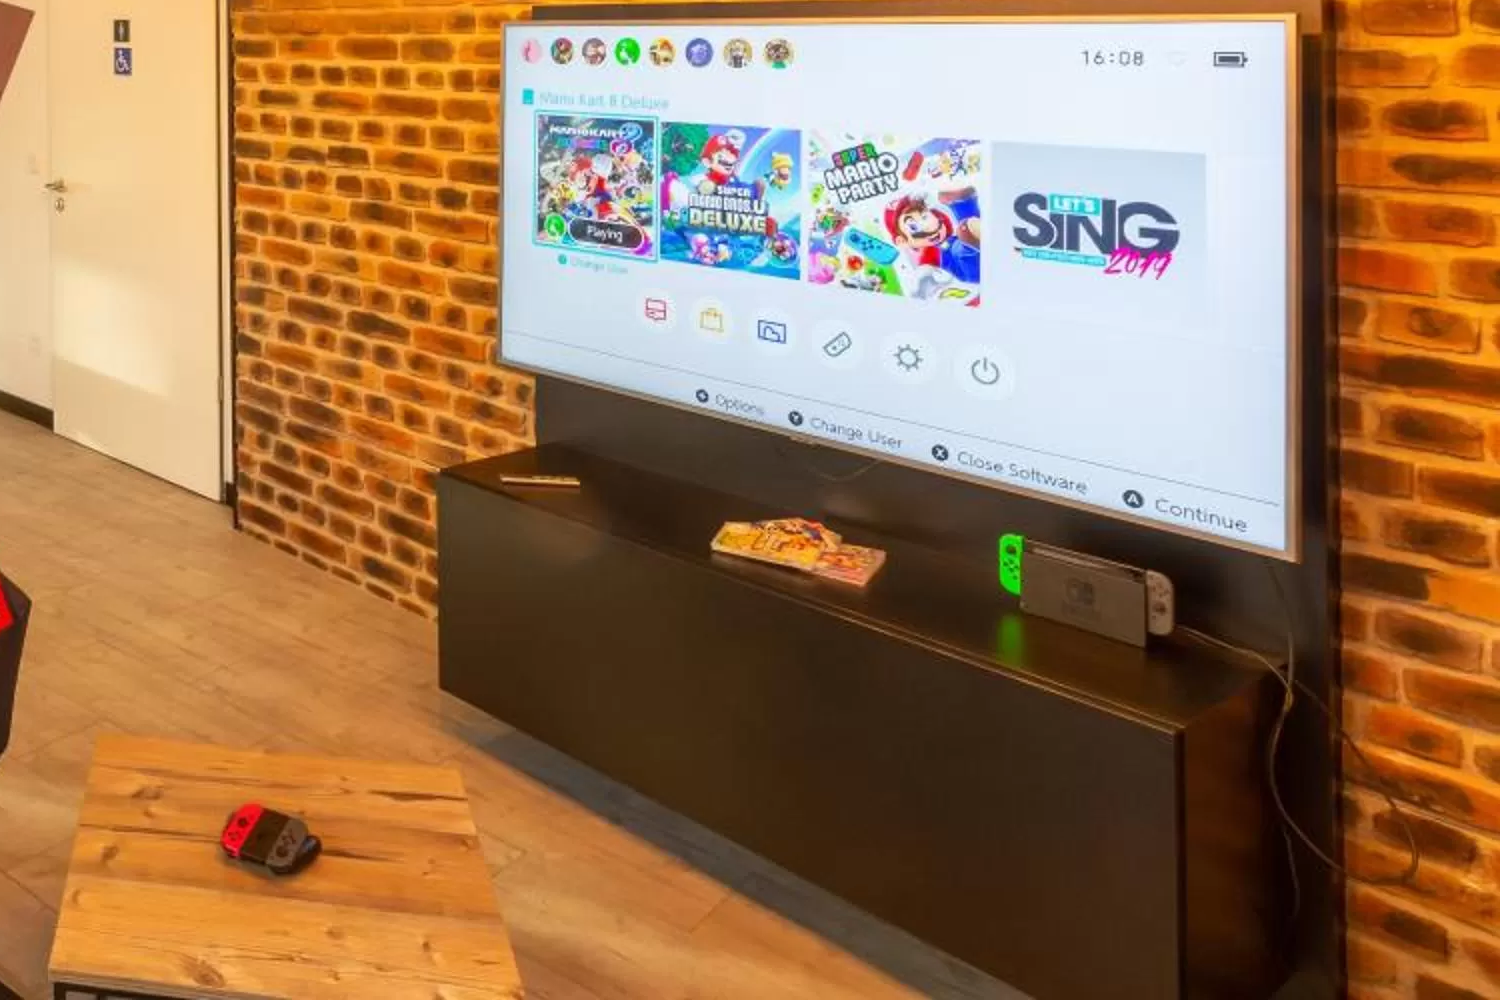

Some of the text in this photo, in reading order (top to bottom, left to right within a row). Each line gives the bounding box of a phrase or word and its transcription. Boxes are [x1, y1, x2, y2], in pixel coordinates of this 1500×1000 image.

[1080, 50, 1144, 66] 16:08
[825, 153, 898, 190] MARIO
[832, 144, 878, 168] SUPER
[836, 173, 899, 204] PARTY
[587, 225, 623, 243] Playing
[689, 207, 767, 234] DELUXE
[1013, 192, 1180, 258] SING
[715, 394, 764, 417] Options
[810, 418, 862, 441] Change
[867, 429, 902, 449] User
[957, 451, 1003, 473] Close
[1008, 463, 1088, 495] Software
[1155, 498, 1248, 533] Continue
